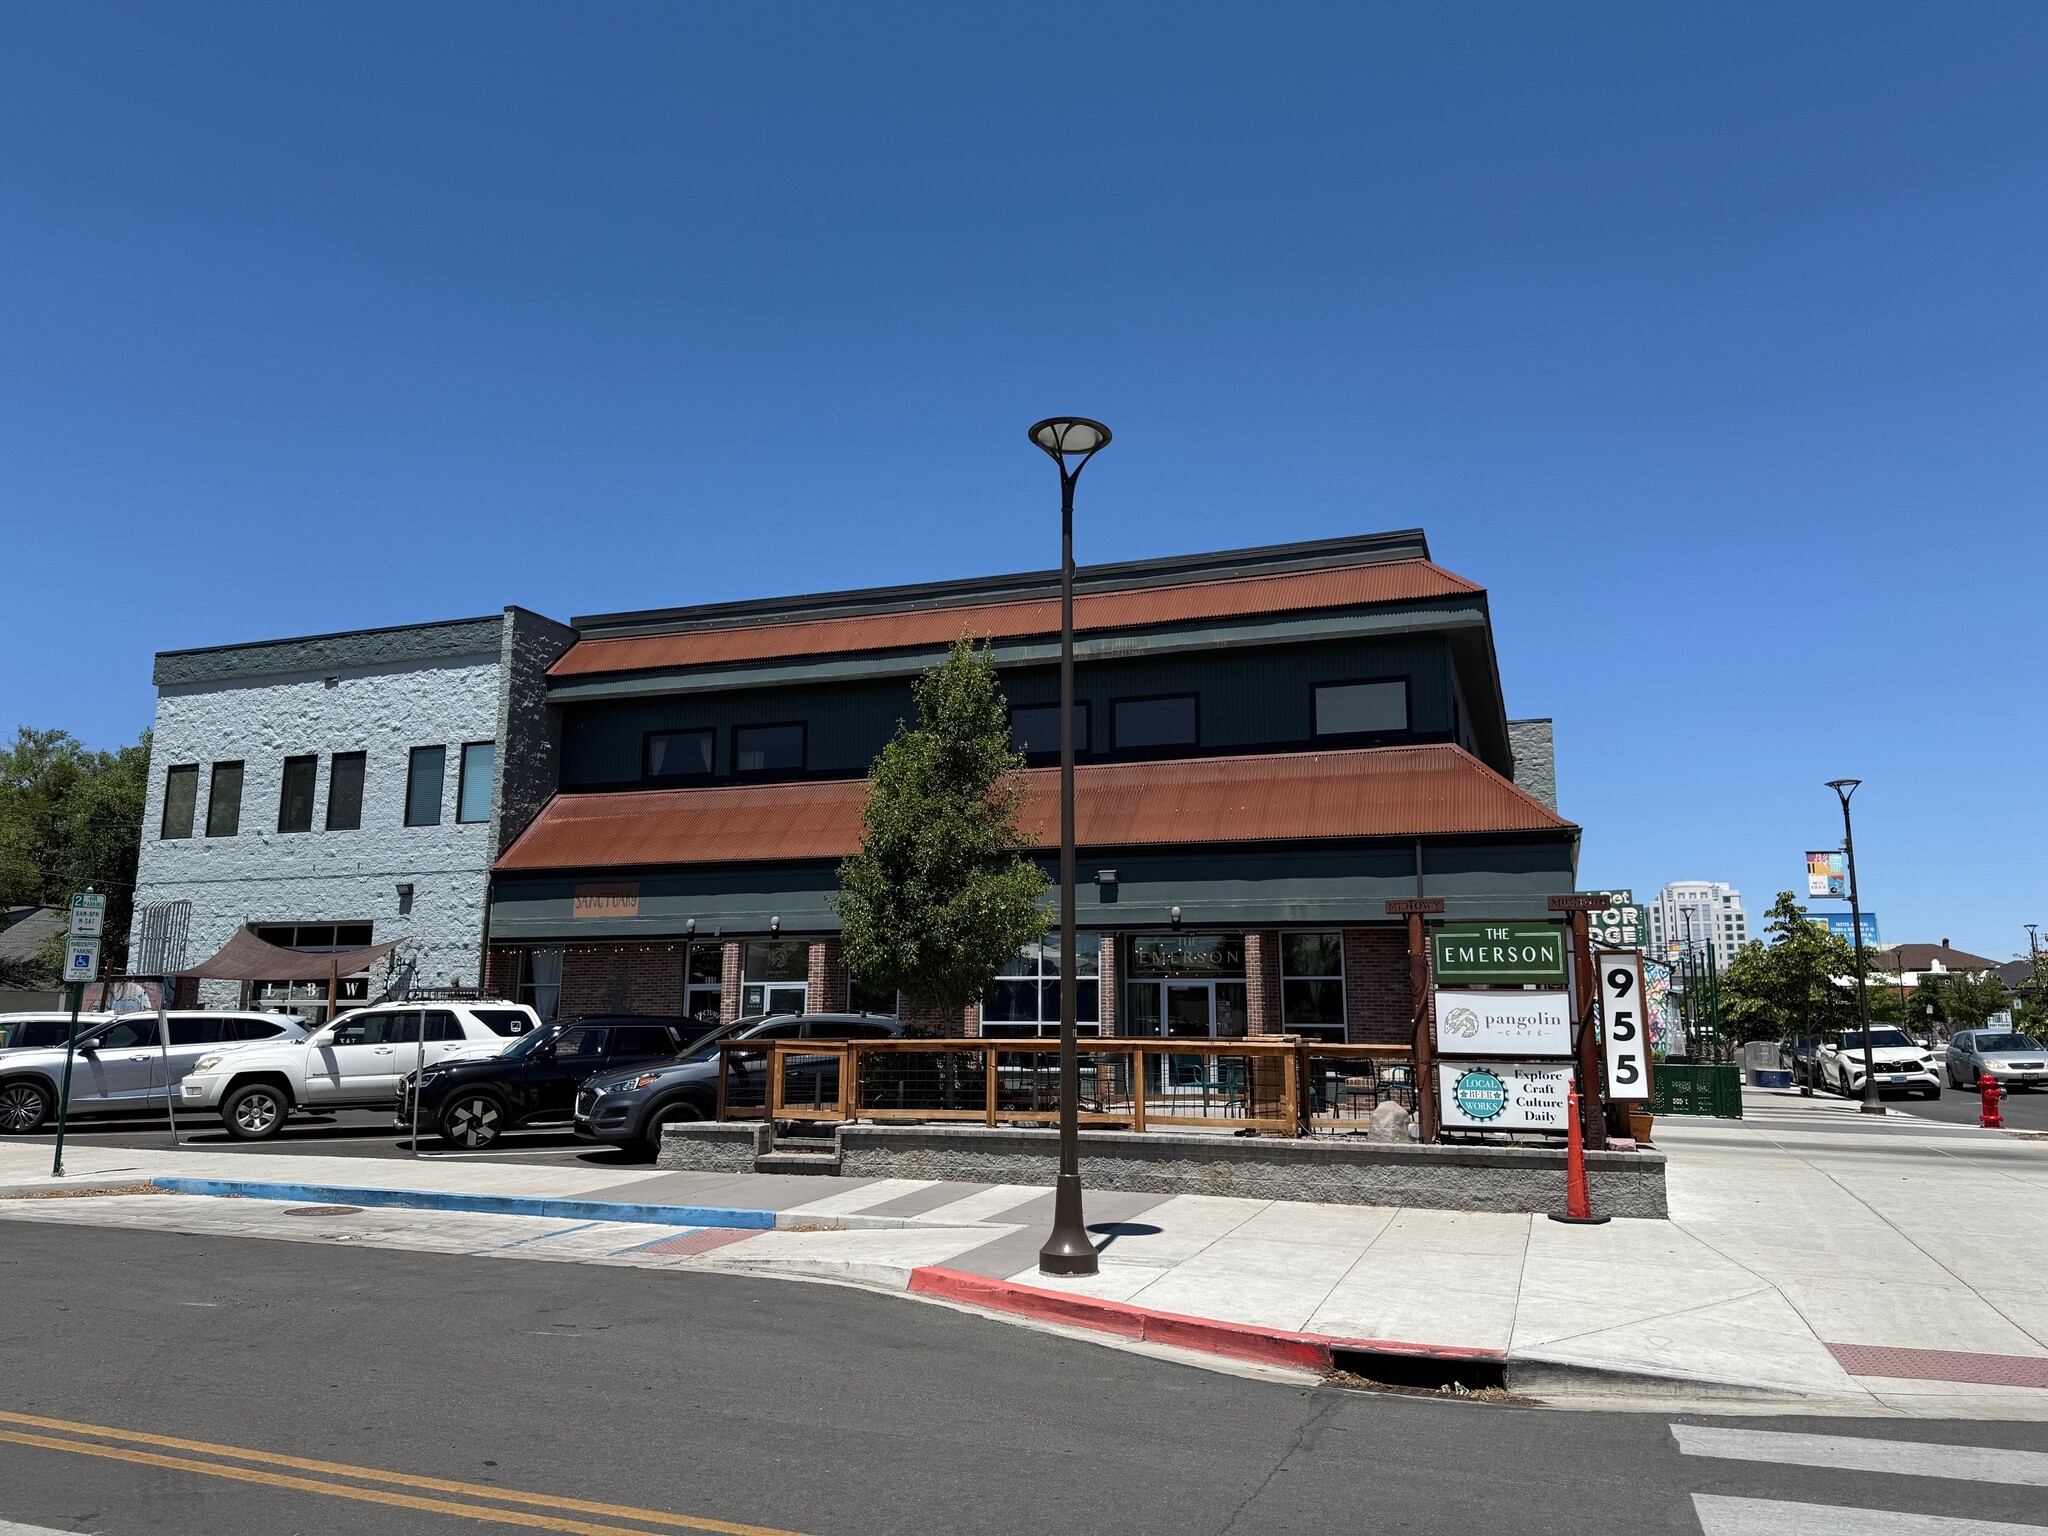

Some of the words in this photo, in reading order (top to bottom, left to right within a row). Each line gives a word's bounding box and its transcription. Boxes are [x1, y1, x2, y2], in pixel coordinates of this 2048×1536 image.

[75, 895, 82, 907] 2
[1587, 907, 1638, 926] TOR
[1485, 928, 1510, 940] THE
[1588, 926, 1637, 944] DGE
[1178, 937, 1198, 947] THE
[1139, 950, 1239, 964] EMERSON
[1445, 946, 1553, 963] EMERSON
[266, 982, 276, 997] L
[307, 982, 318, 997] B
[345, 982, 360, 997] W
[1484, 1012, 1561, 1030] pangolin
[1514, 1069, 1562, 1082] Explore
[1466, 1079, 1498, 1088] LOCAL
[1523, 1084, 1555, 1094] Craft
[1469, 1090, 1493, 1099] BEER
[1465, 1101, 1498, 1111] WORKS
[1516, 1097, 1564, 1108] Culture
[1525, 1111, 1557, 1124] Daily
